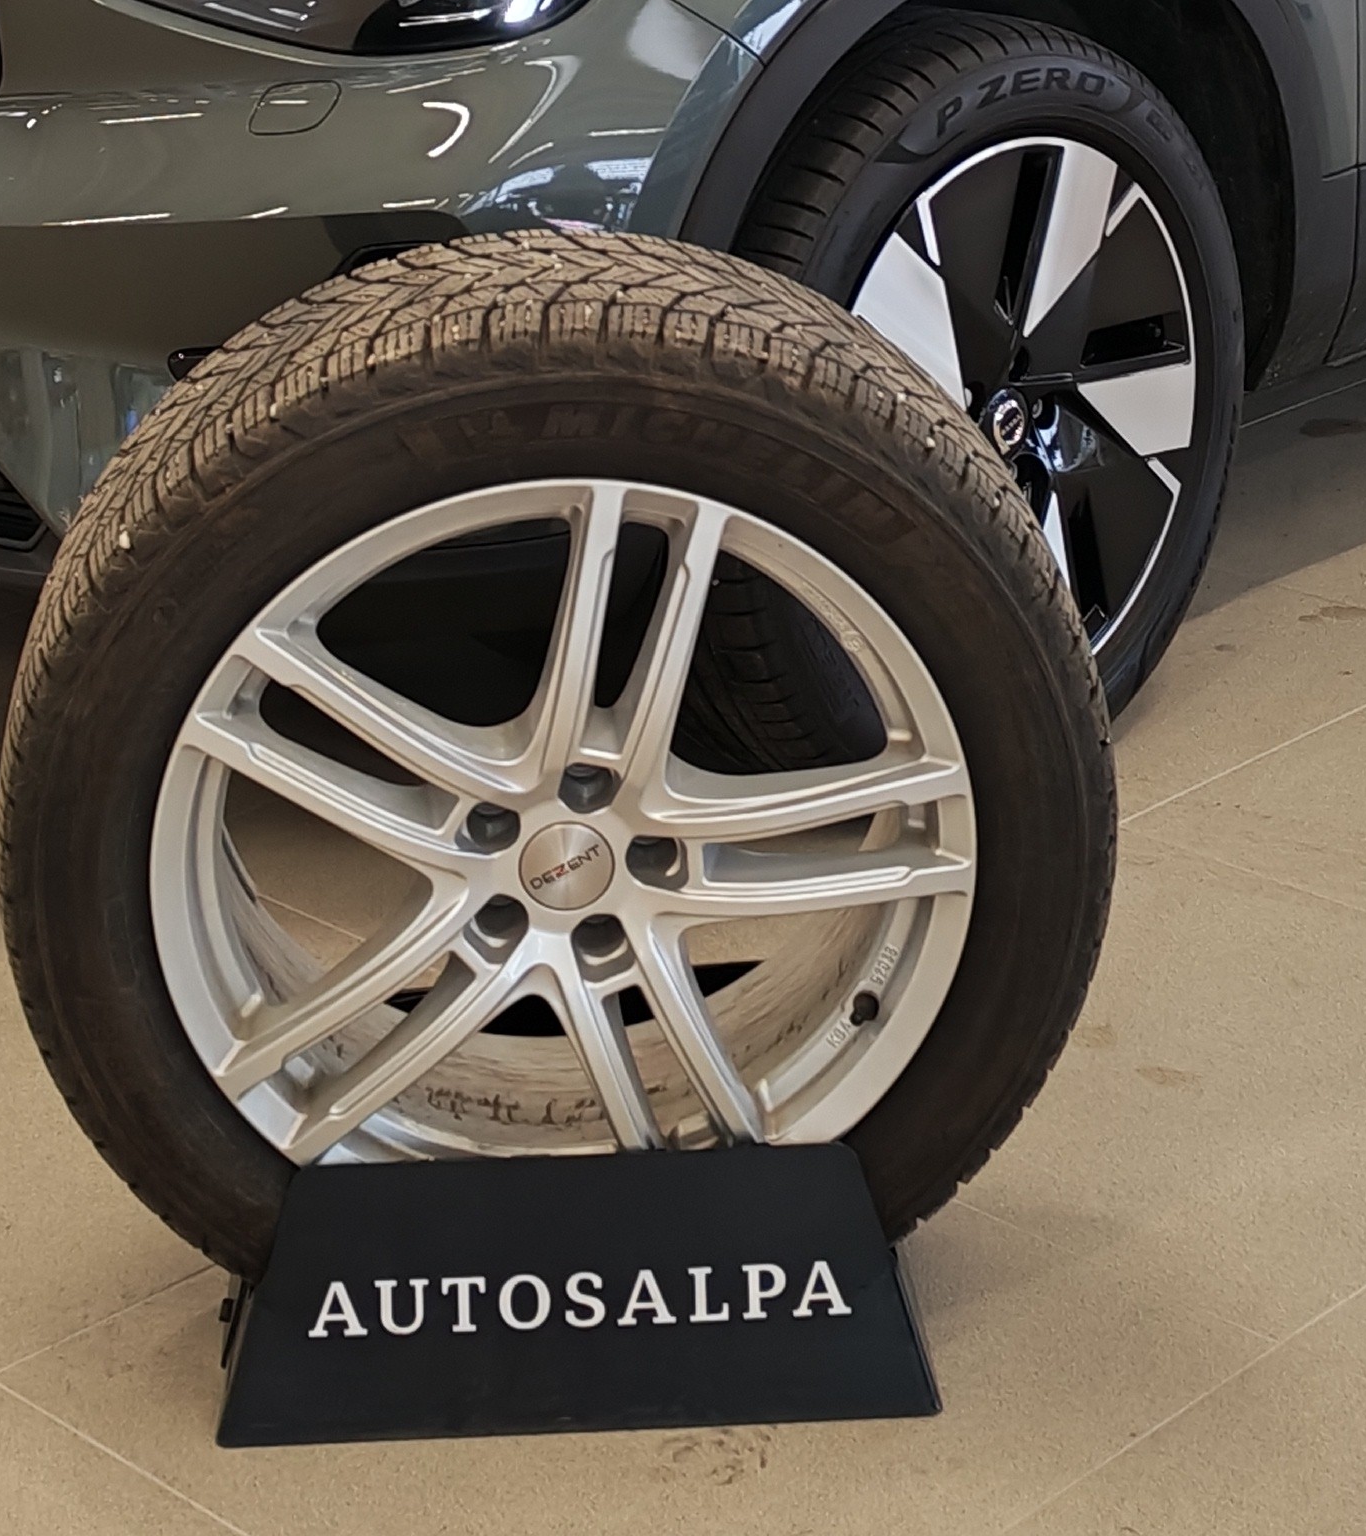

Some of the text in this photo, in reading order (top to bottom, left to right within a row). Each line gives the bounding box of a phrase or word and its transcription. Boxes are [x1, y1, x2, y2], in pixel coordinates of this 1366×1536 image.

[936, 67, 1107, 138] P ZERO
[529, 843, 601, 890] DEZENT
[307, 1260, 852, 1339] AUTOSALPA
